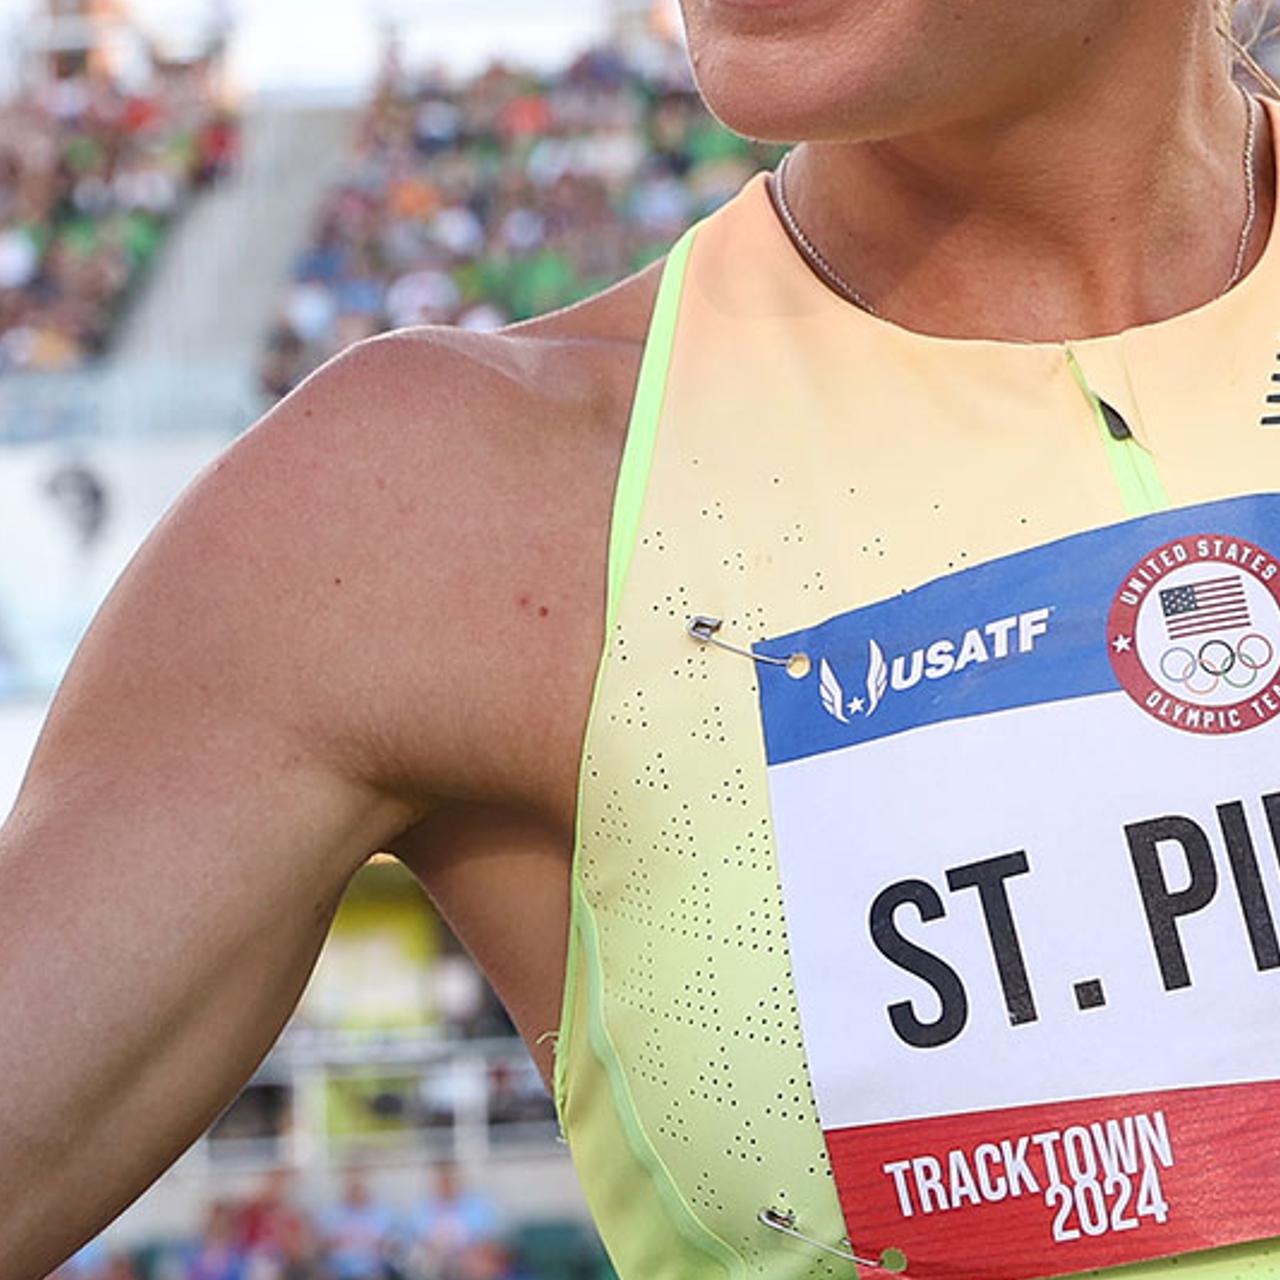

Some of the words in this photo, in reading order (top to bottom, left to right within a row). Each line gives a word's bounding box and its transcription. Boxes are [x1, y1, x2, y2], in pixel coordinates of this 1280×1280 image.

[1120, 543, 1188, 605] UNITED
[1197, 539, 1278, 580] STATES
[890, 607, 1050, 691] USATF
[1145, 690, 1242, 728] OLYMPIC
[867, 849, 1109, 1049] ST.
[882, 1110, 1174, 1217] TRACKTOWN
[1044, 1163, 1170, 1243] 2024
